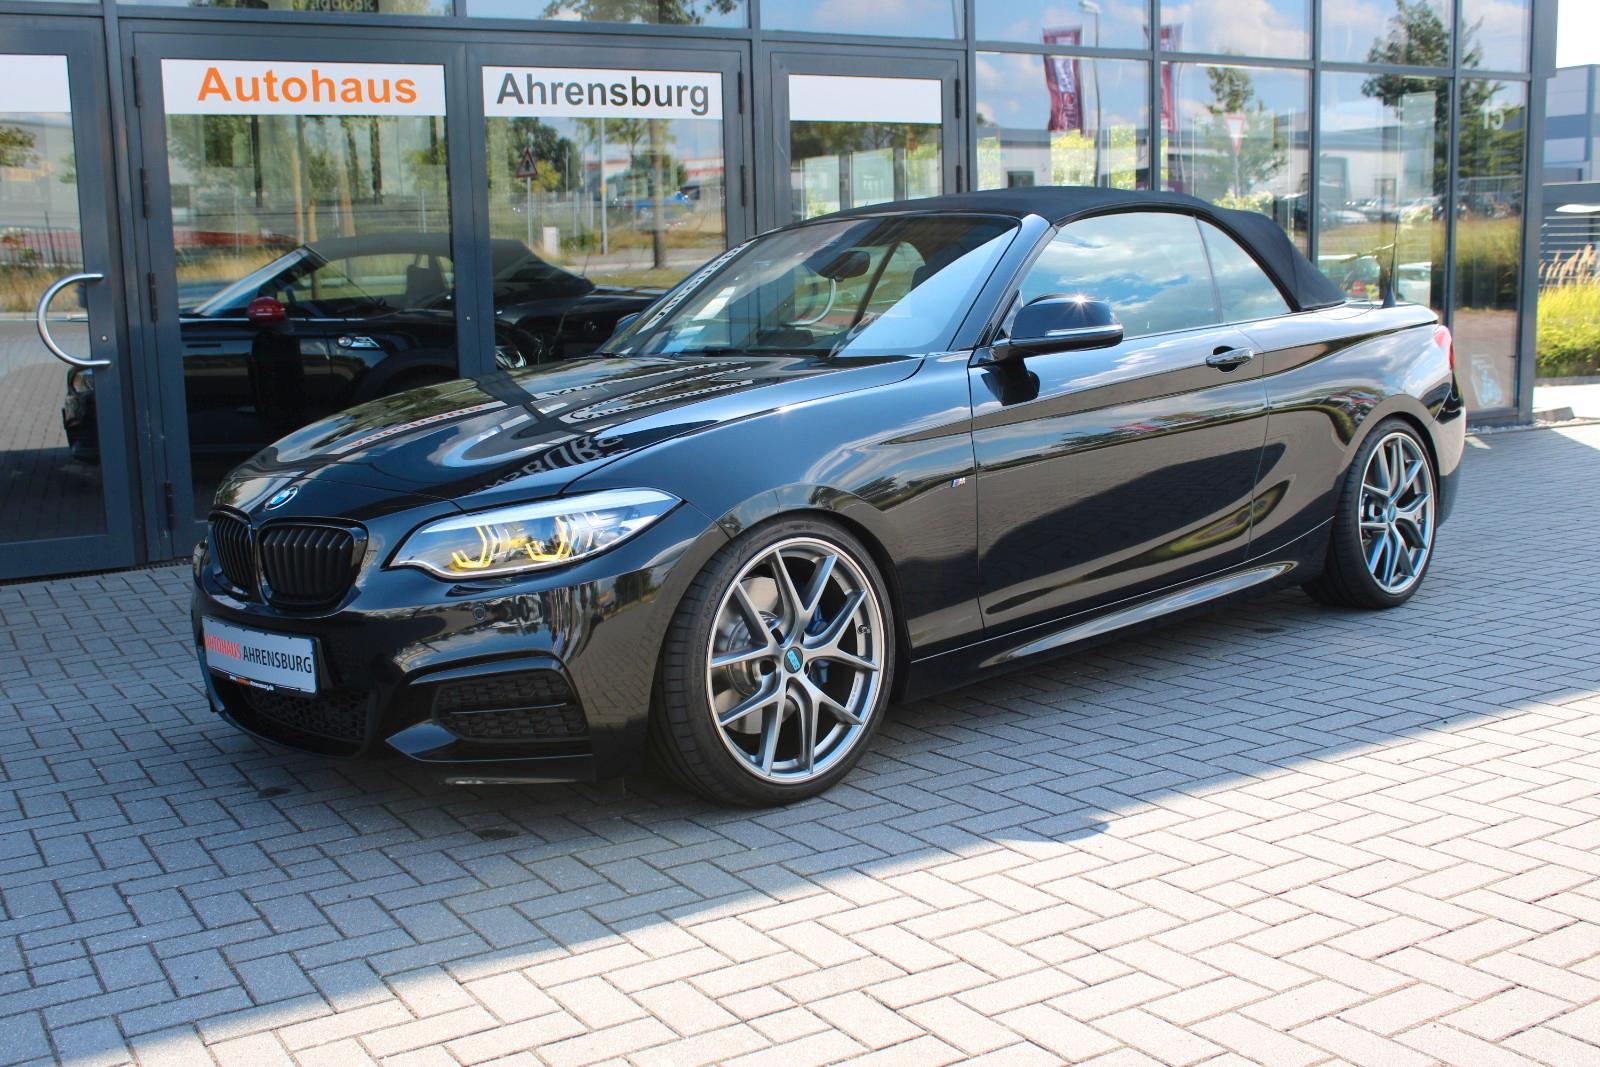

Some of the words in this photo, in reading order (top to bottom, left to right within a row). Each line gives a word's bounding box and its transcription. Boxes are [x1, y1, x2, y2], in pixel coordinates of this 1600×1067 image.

[197, 67, 416, 103] Autohaus
[496, 73, 709, 116] Ahrensburg
[1480, 100, 1505, 130] 15
[204, 632, 240, 660] AUTOHAUS
[243, 645, 312, 674] AHRENSBURG
